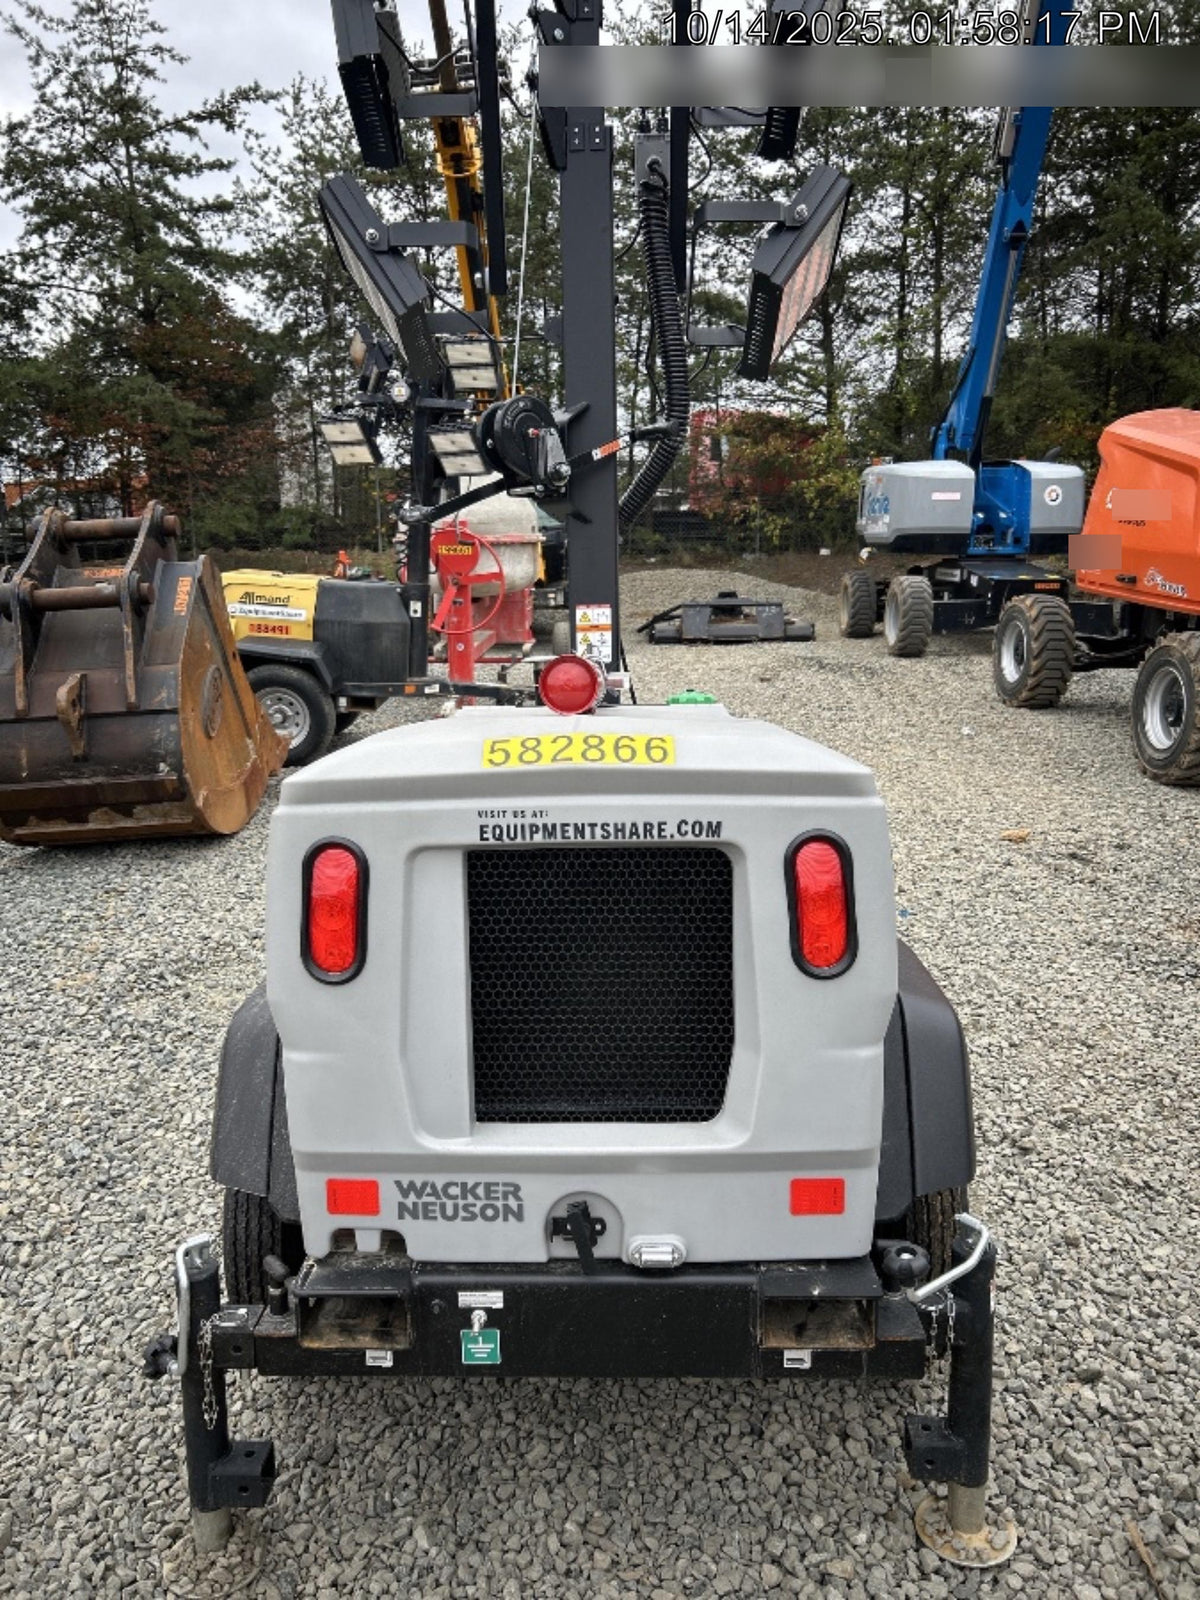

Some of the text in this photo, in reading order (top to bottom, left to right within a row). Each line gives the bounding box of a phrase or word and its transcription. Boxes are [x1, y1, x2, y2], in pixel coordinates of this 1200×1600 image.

[486, 734, 670, 767] 582866
[477, 809, 549, 819] VISIT US AT:
[479, 819, 723, 842] EQUIPMENTSHARE.COM
[393, 1180, 523, 1202] WACKER
[397, 1201, 525, 1222] NEUSON
